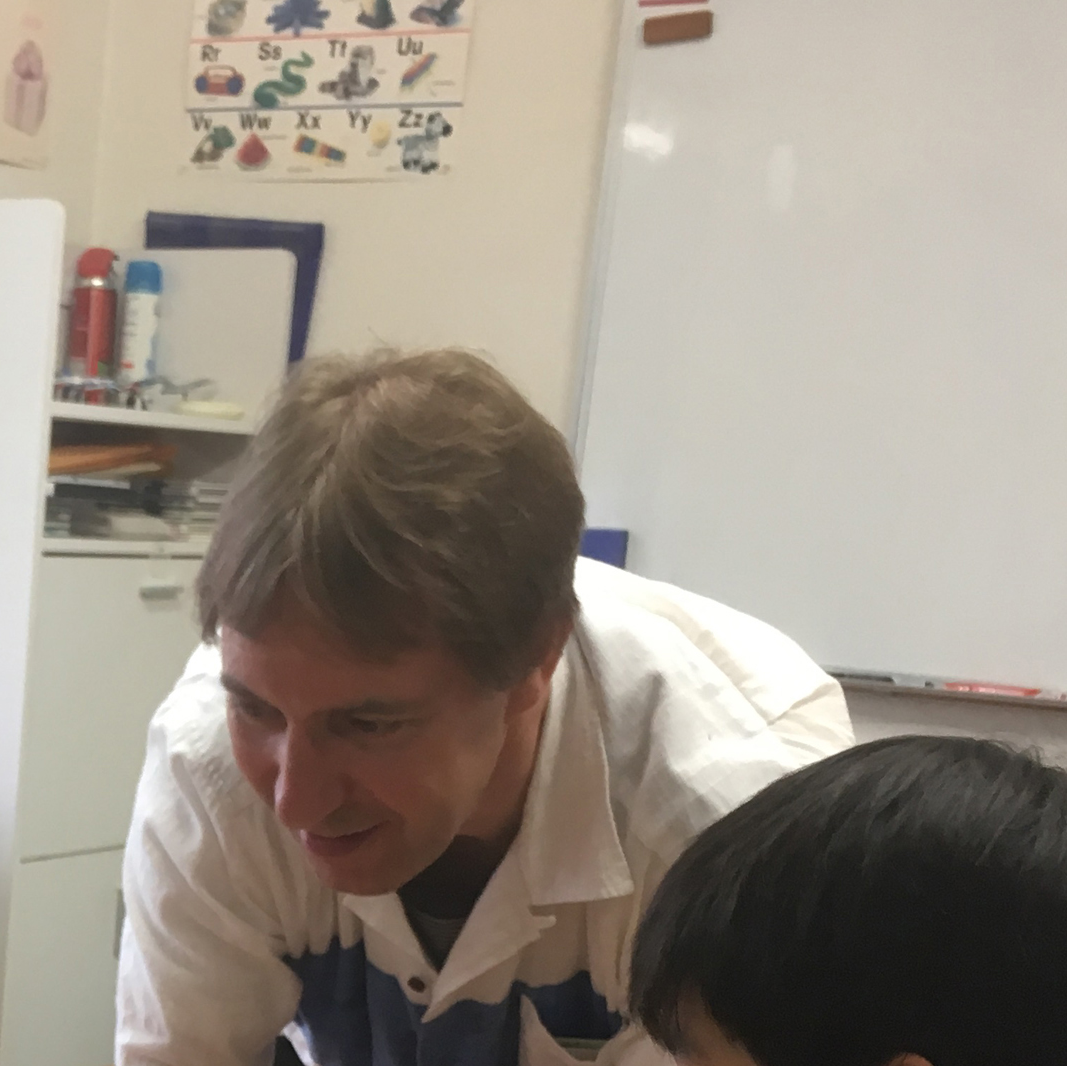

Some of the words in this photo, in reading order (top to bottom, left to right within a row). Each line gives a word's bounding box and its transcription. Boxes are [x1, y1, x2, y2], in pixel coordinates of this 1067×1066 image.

[200, 44, 222, 62] Rr
[258, 42, 282, 60] Ss
[396, 37, 424, 56] Uu
[191, 112, 212, 131] Vv
[239, 113, 271, 130] Ww
[297, 112, 322, 130] Xx
[347, 111, 372, 133] Yy
[398, 110, 423, 128] Zz
